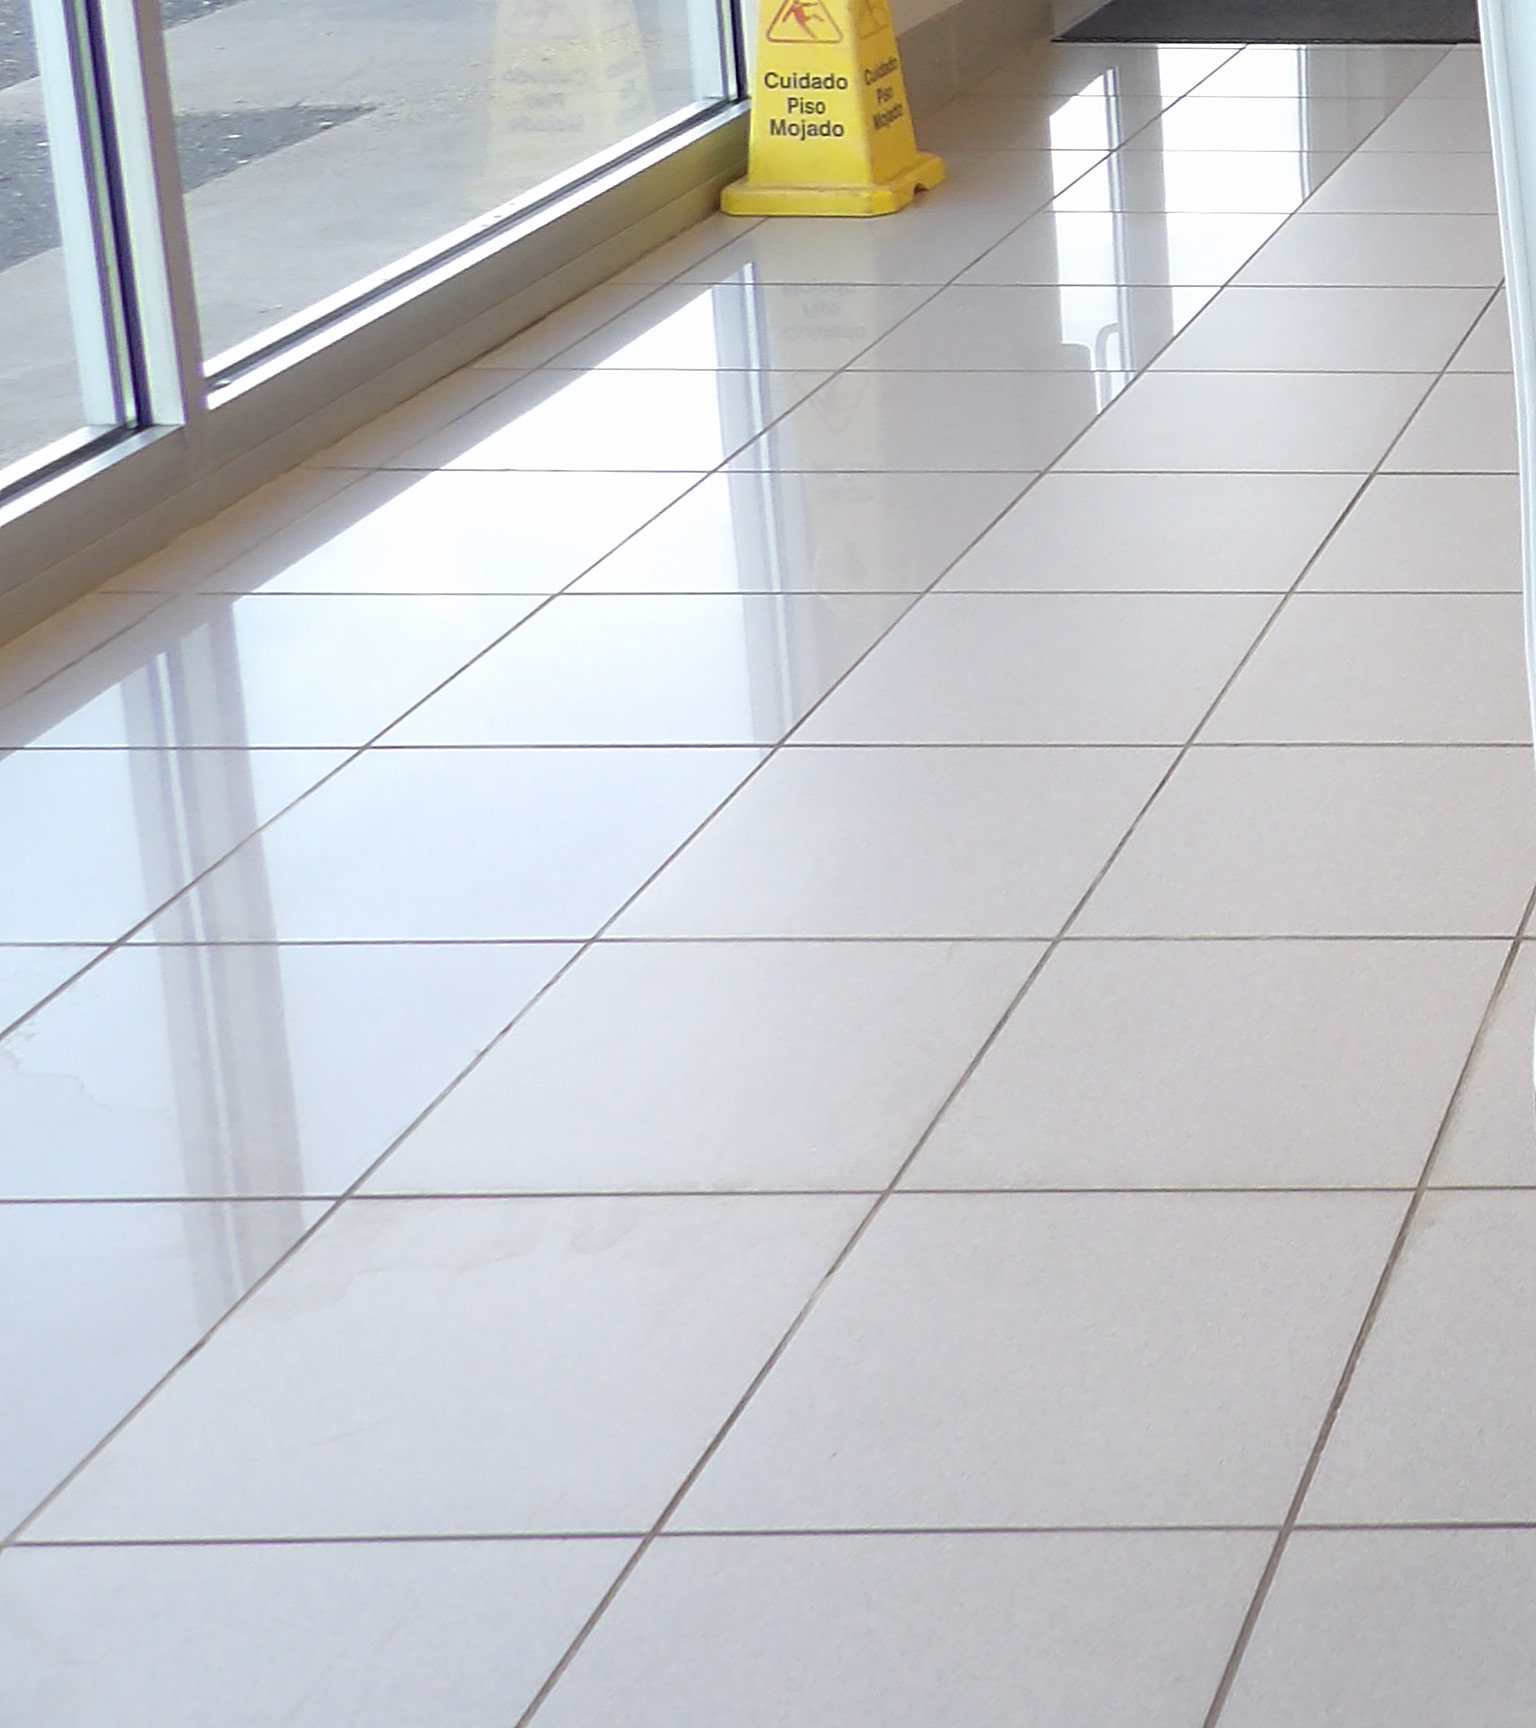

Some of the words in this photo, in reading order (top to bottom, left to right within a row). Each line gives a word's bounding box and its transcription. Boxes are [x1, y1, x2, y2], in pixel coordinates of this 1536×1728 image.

[764, 71, 848, 90] Cuidado
[787, 97, 826, 114] Piso
[769, 119, 844, 141] Mojado
